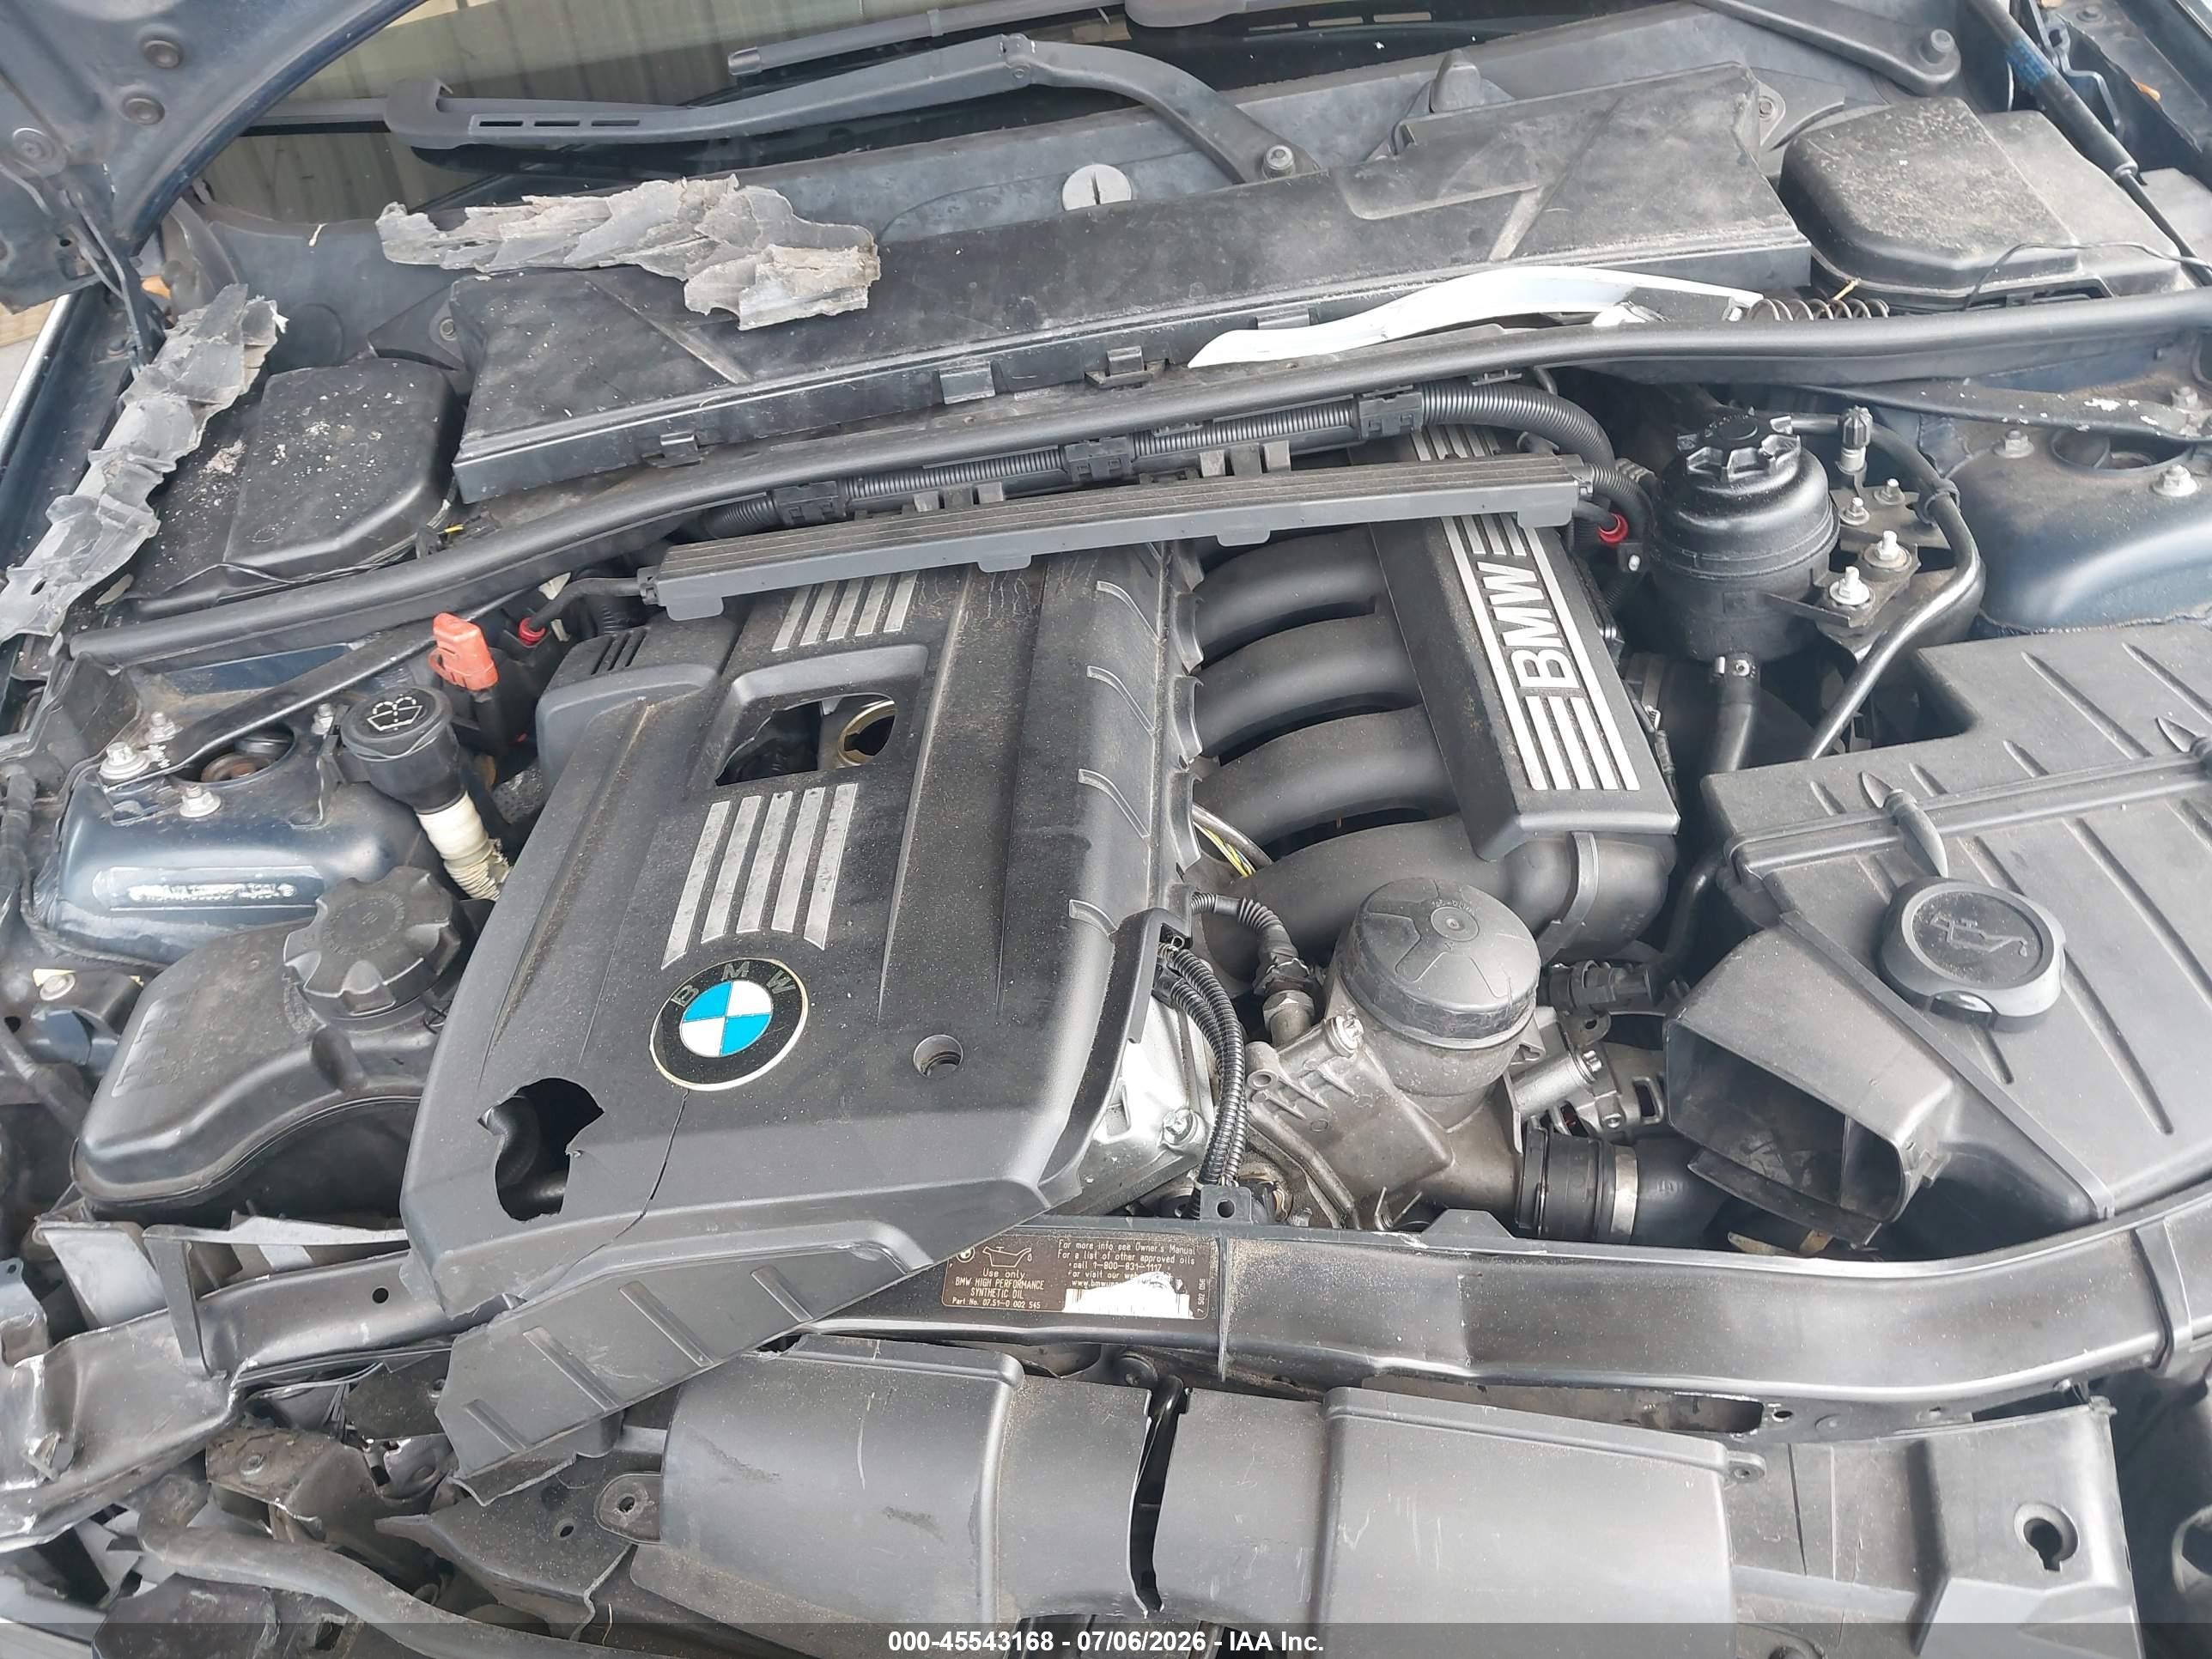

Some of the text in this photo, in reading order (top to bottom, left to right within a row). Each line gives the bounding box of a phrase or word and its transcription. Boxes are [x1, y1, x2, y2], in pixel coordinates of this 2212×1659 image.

[1477, 561, 1580, 688] BMW
[670, 960, 797, 1007] BMW
[1059, 1238, 1072, 1249] For
[1098, 1240, 1114, 1251] info
[1135, 1242, 1165, 1253] Owner's
[1169, 1243, 1196, 1255] Manual
[1057, 1249, 1071, 1259] For
[1084, 1249, 1097, 1260] list
[1102, 1250, 1111, 1261] of
[1115, 1251, 1136, 1261] other
[1139, 1254, 1176, 1264] approved
[1179, 1255, 1195, 1265] oils
[982, 1267, 1026, 1280] Use only
[1092, 1261, 1163, 1272] 1-800-831-1117
[1085, 1269, 1103, 1279] visit
[955, 1276, 1045, 1291] BMW HIGH PERFORMANCE
[970, 1287, 1024, 1300] SYNTHETIC OIL
[951, 1297, 965, 1305] Part
[969, 1297, 979, 1305] No.
[1013, 1300, 1026, 1309] 002
